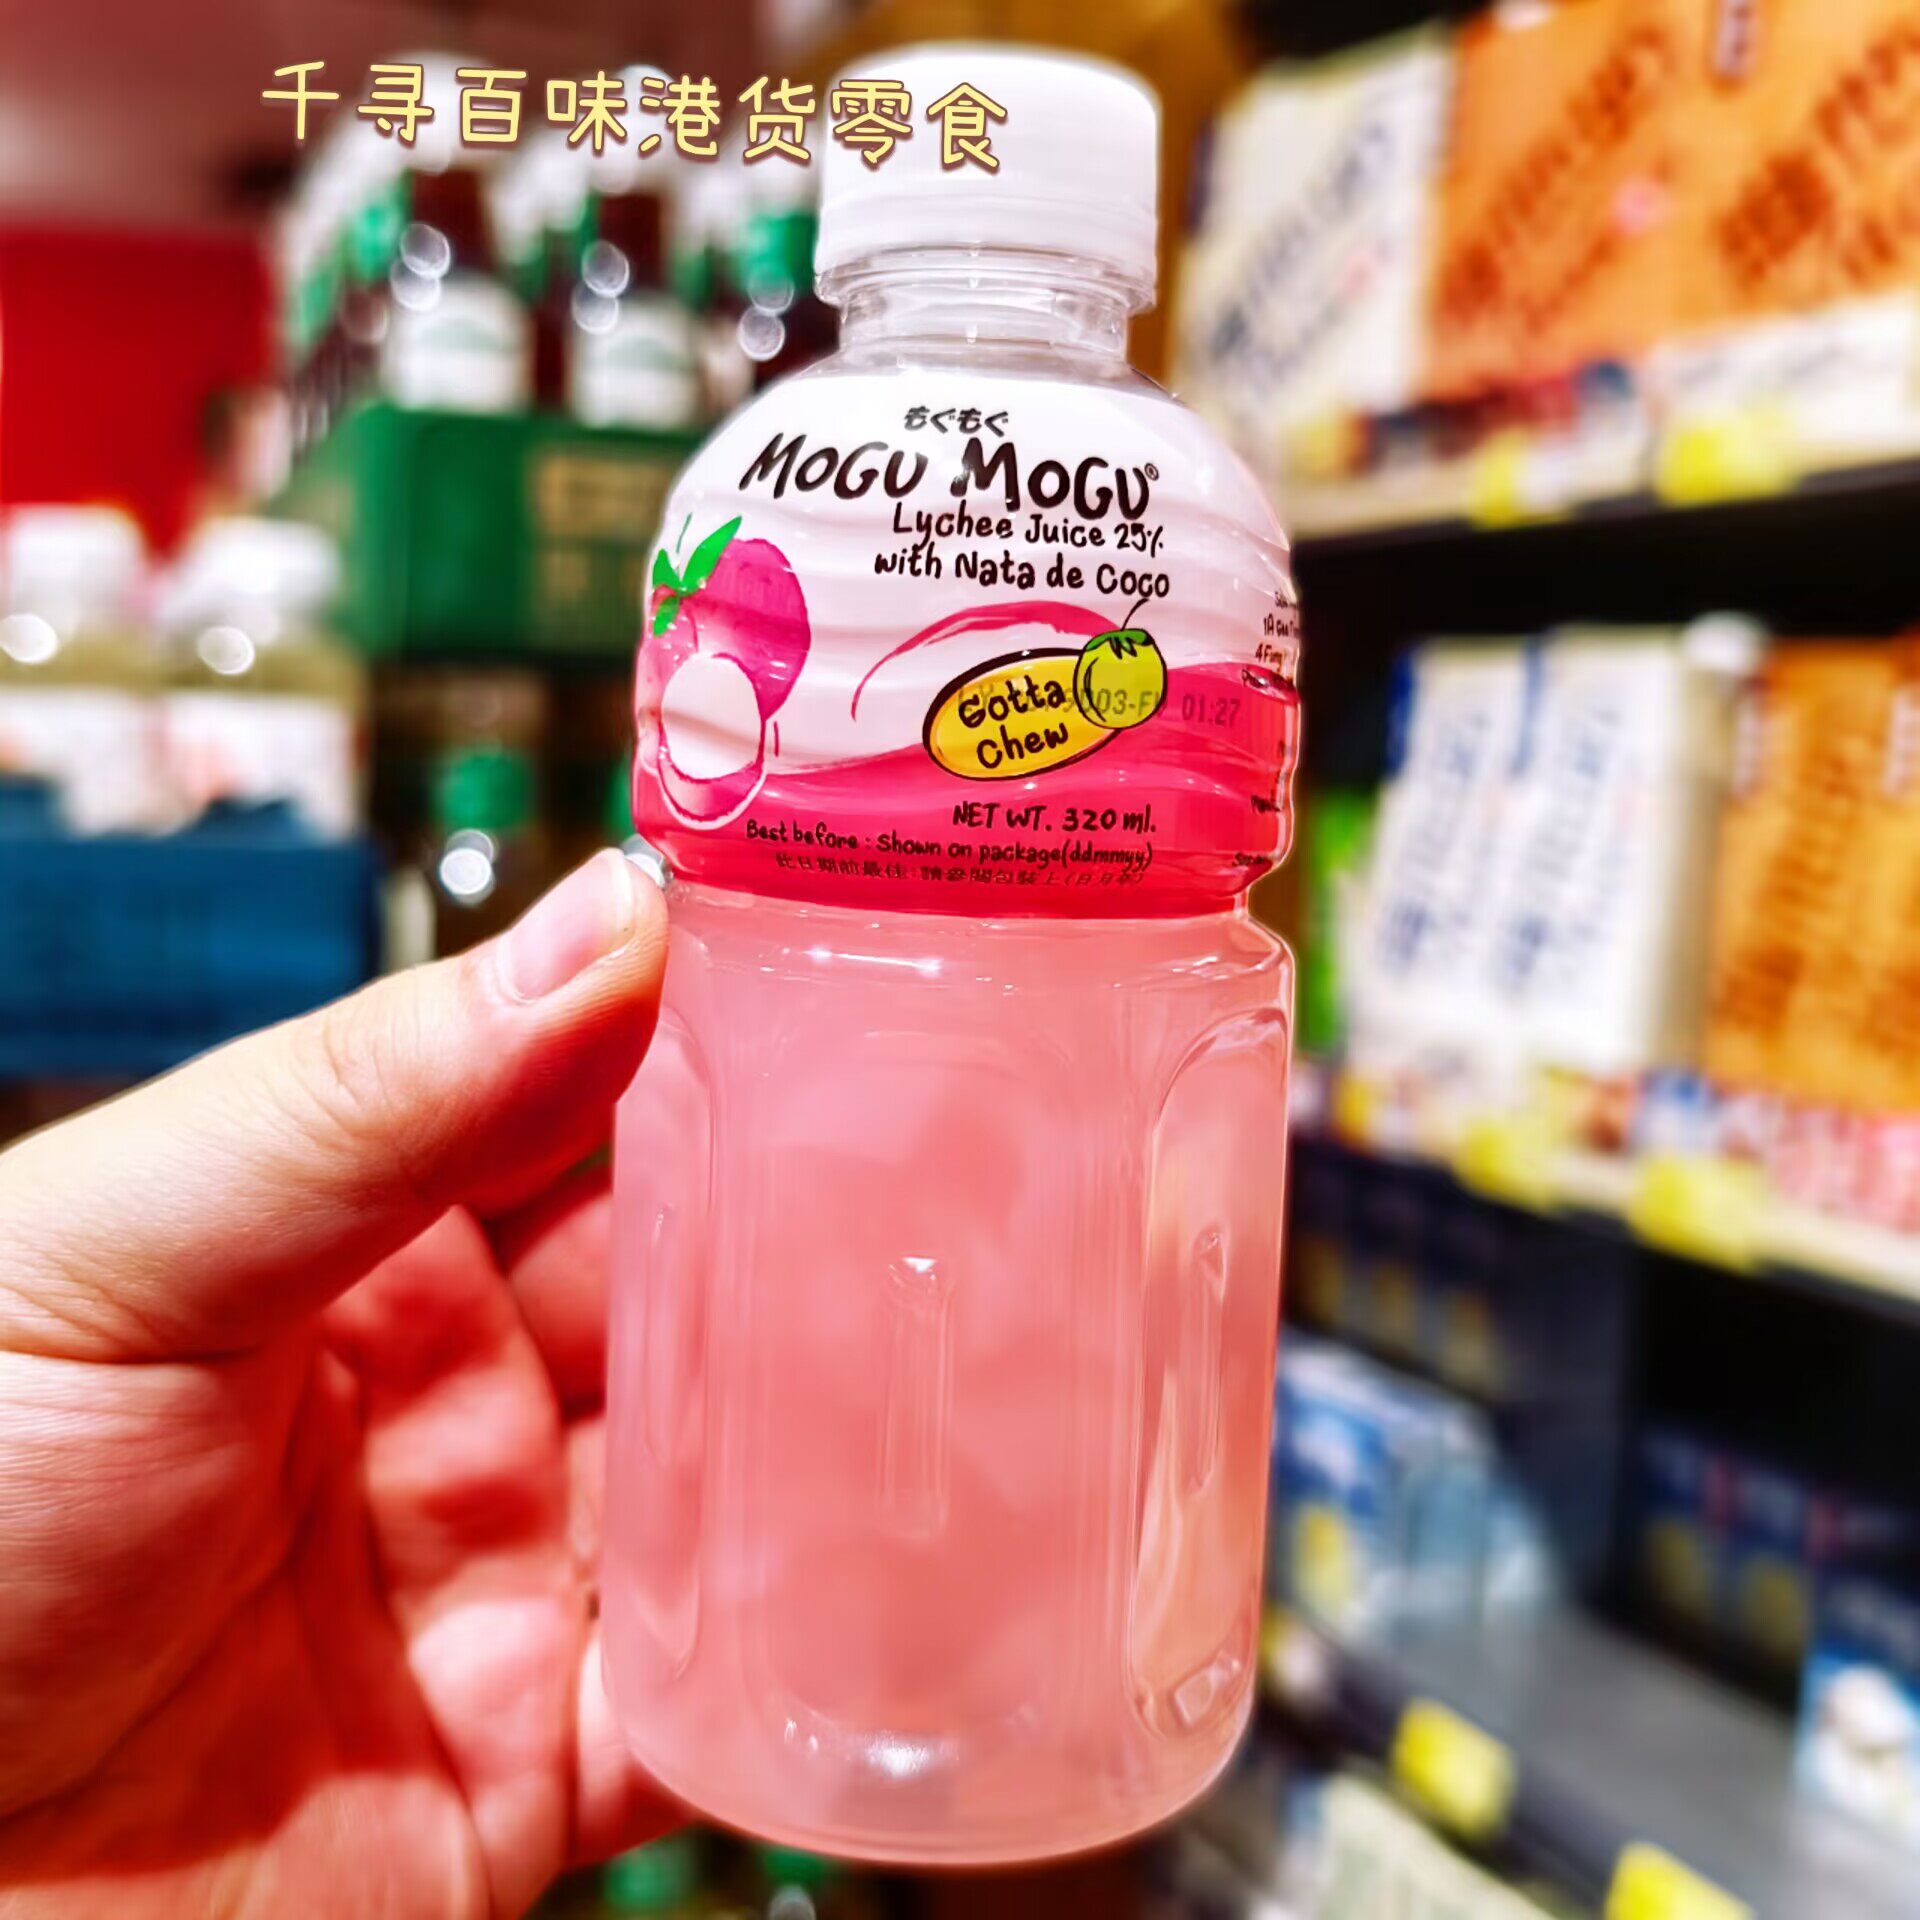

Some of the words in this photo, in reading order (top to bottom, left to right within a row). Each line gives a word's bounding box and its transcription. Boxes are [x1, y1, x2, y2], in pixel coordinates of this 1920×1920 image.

[904, 405, 1008, 437] もぐもぐ
[893, 500, 1013, 548] Lychee
[1025, 514, 1105, 547] Juice
[1114, 523, 1163, 557] 25%
[874, 543, 942, 579] with
[955, 550, 1036, 589] Nata
[1046, 553, 1084, 588] de
[1096, 564, 1170, 597] Coco
[958, 675, 1067, 729] Gotta
[1181, 694, 1241, 729] 01:27
[976, 722, 1069, 769] Chew
[747, 819, 788, 842] Best
[793, 820, 858, 849] before
[948, 842, 972, 858] on
[953, 801, 1000, 828] NET
[1006, 805, 1052, 831] WT.
[1062, 808, 1117, 831] 320
[1123, 803, 1156, 834] ml.
